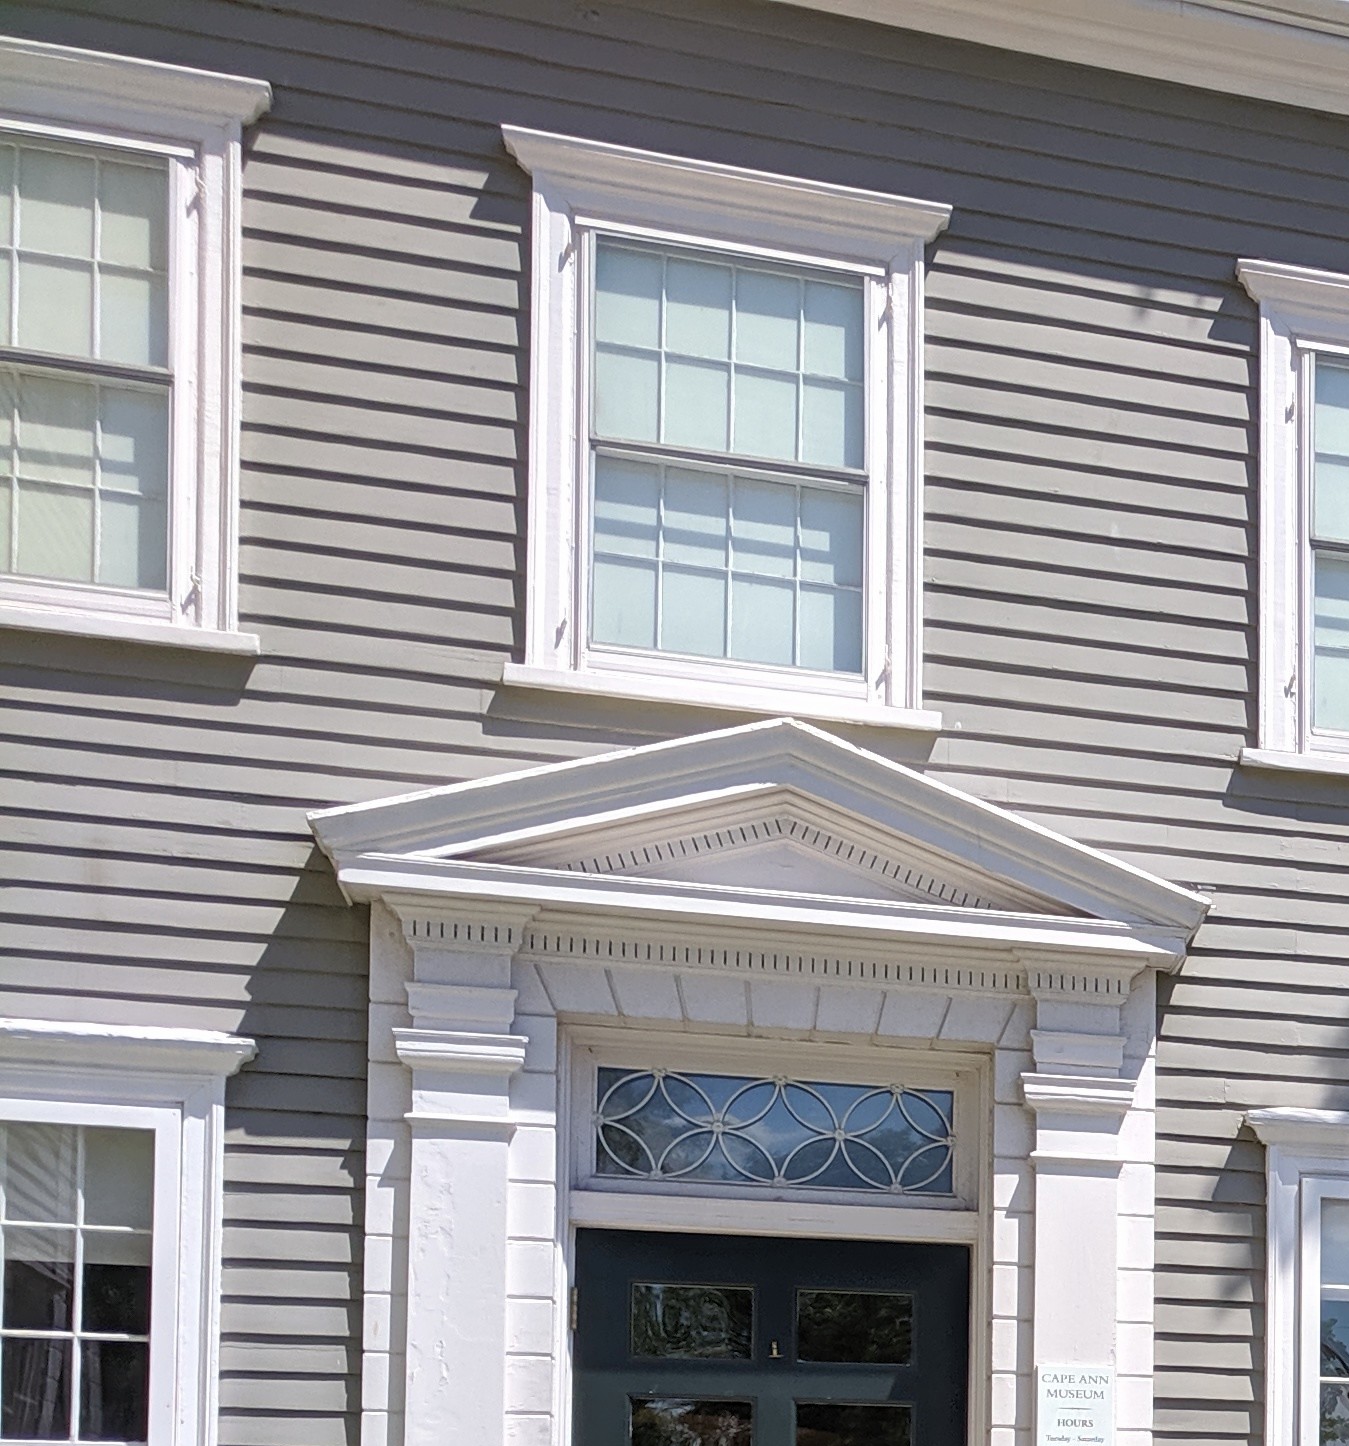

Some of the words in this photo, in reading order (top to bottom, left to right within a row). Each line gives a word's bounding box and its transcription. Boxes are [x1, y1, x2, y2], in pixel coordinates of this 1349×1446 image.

[1041, 1373, 1075, 1384] CAPE
[1078, 1375, 1109, 1385] ANN
[1046, 1389, 1105, 1400] MUSEUM
[1057, 1418, 1094, 1428] HOURS
